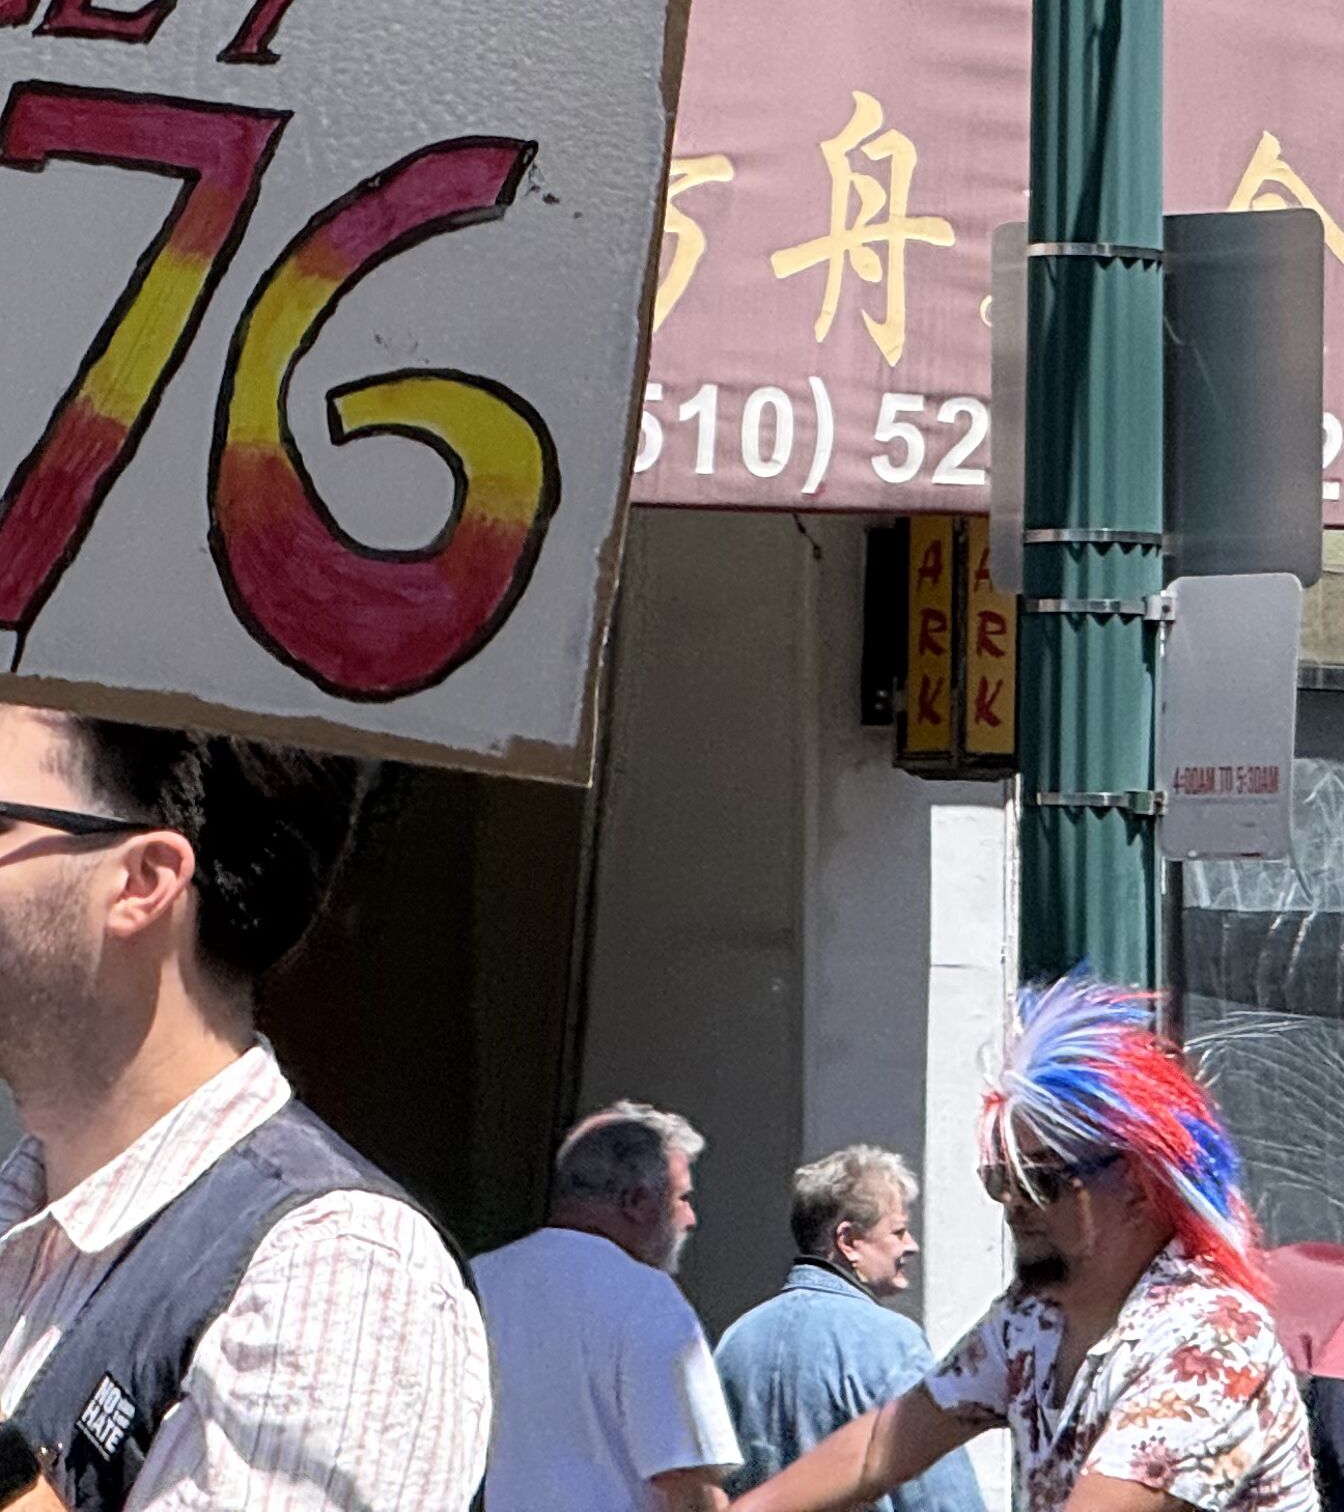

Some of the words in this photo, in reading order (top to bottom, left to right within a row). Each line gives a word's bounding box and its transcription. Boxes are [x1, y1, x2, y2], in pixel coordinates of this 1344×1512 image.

[916, 538, 948, 726] ARK
[94, 1375, 122, 1414] NO
[81, 1399, 125, 1455] HATE
